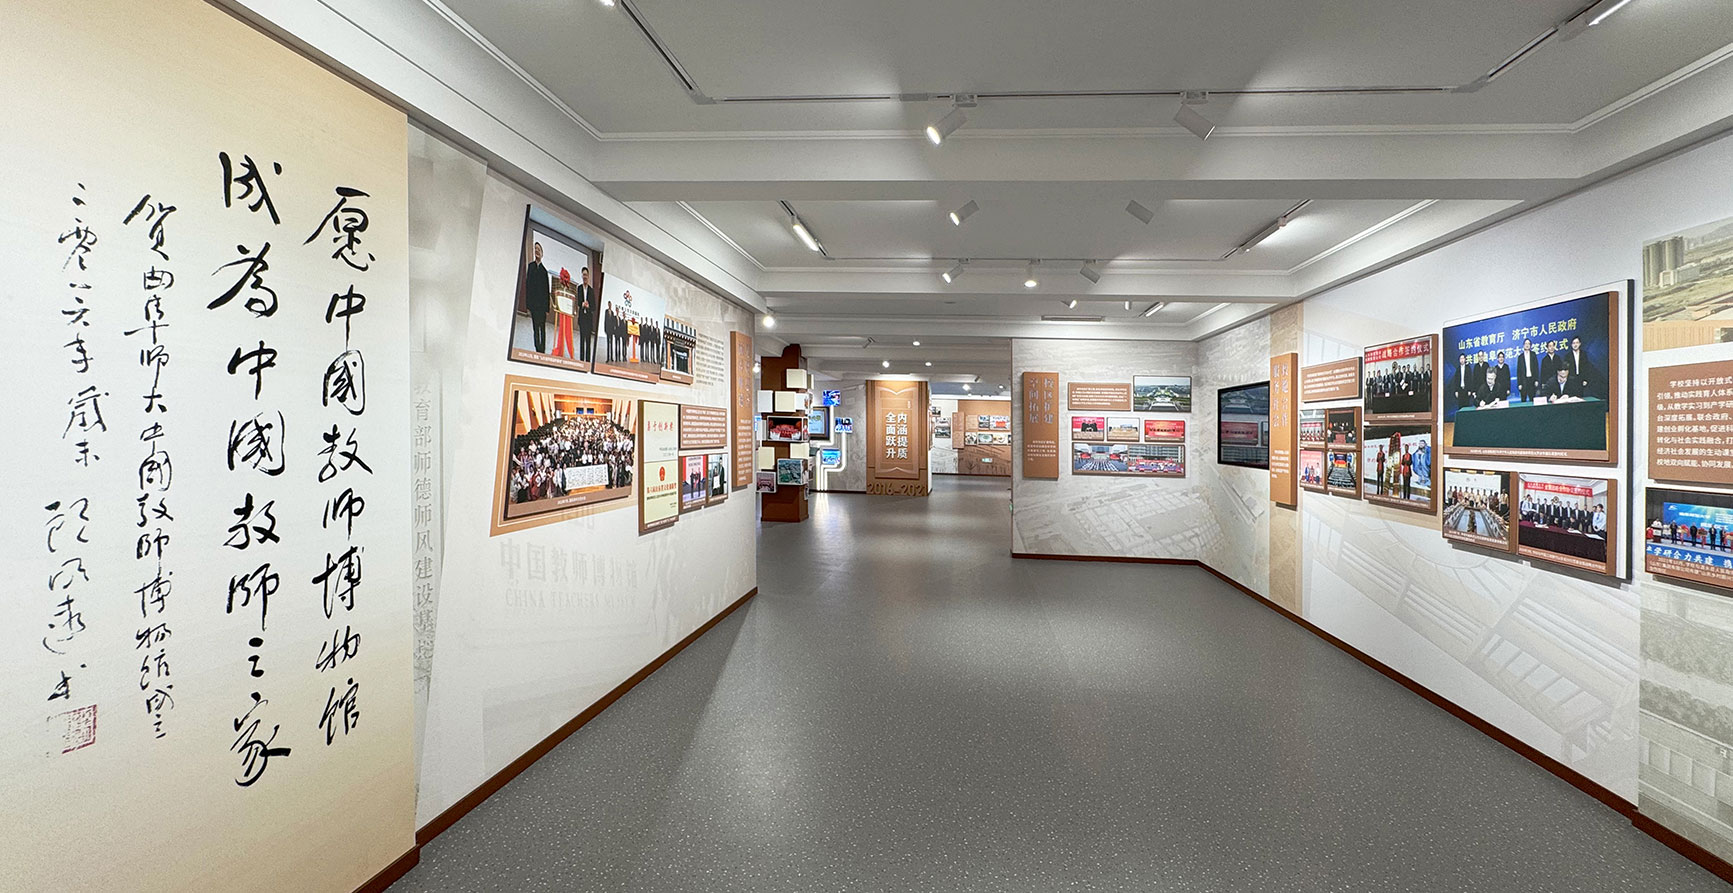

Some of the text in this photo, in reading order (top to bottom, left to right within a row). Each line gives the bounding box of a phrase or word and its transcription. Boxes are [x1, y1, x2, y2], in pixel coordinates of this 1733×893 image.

[1458, 318, 1577, 350] 山东省教育厅 济宁市人民政府
[1669, 376, 1733, 388] 学校坚持以开放式
[885, 412, 896, 459] 全面跃升
[897, 412, 908, 460] 内涵提质
